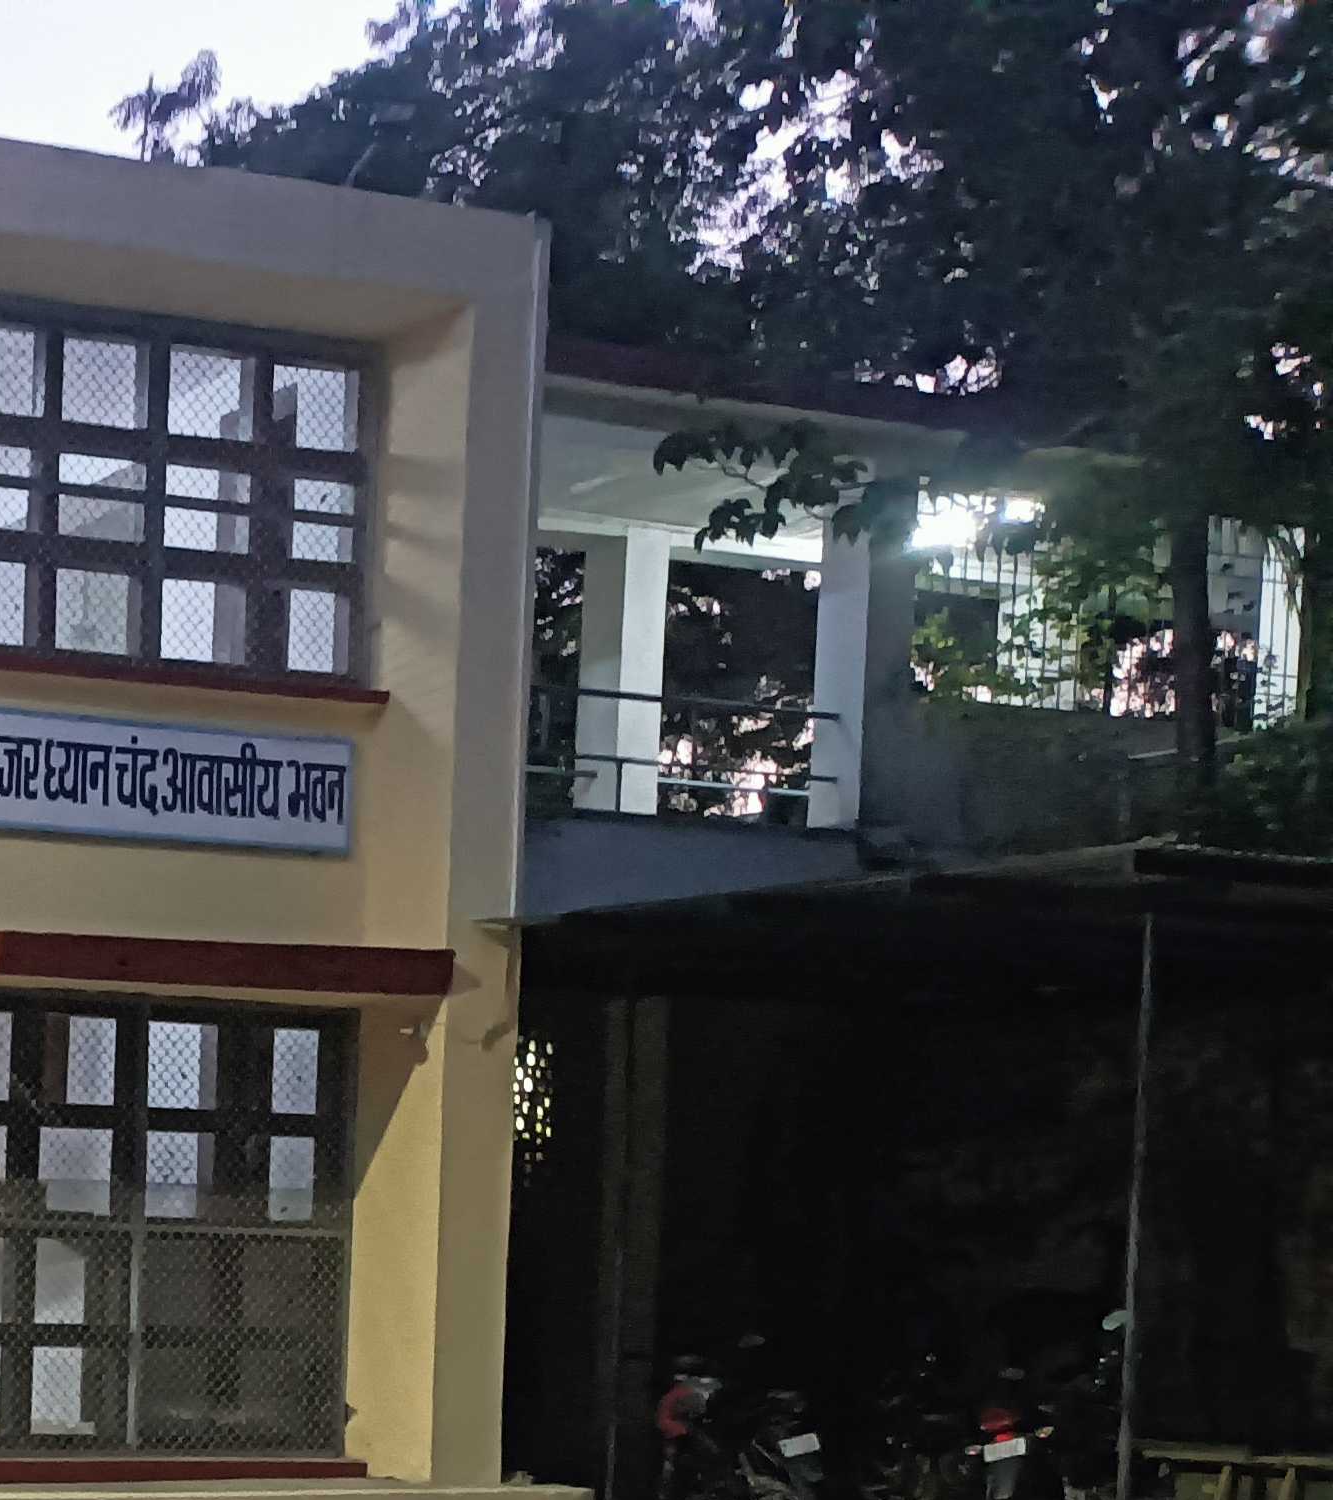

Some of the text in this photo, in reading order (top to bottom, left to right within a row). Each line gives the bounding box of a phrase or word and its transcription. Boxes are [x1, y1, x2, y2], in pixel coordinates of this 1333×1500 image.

[43, 738, 113, 807] ध्यान
[115, 735, 159, 816] चंद
[161, 742, 283, 820] आवासीय
[286, 759, 347, 825] भवन
